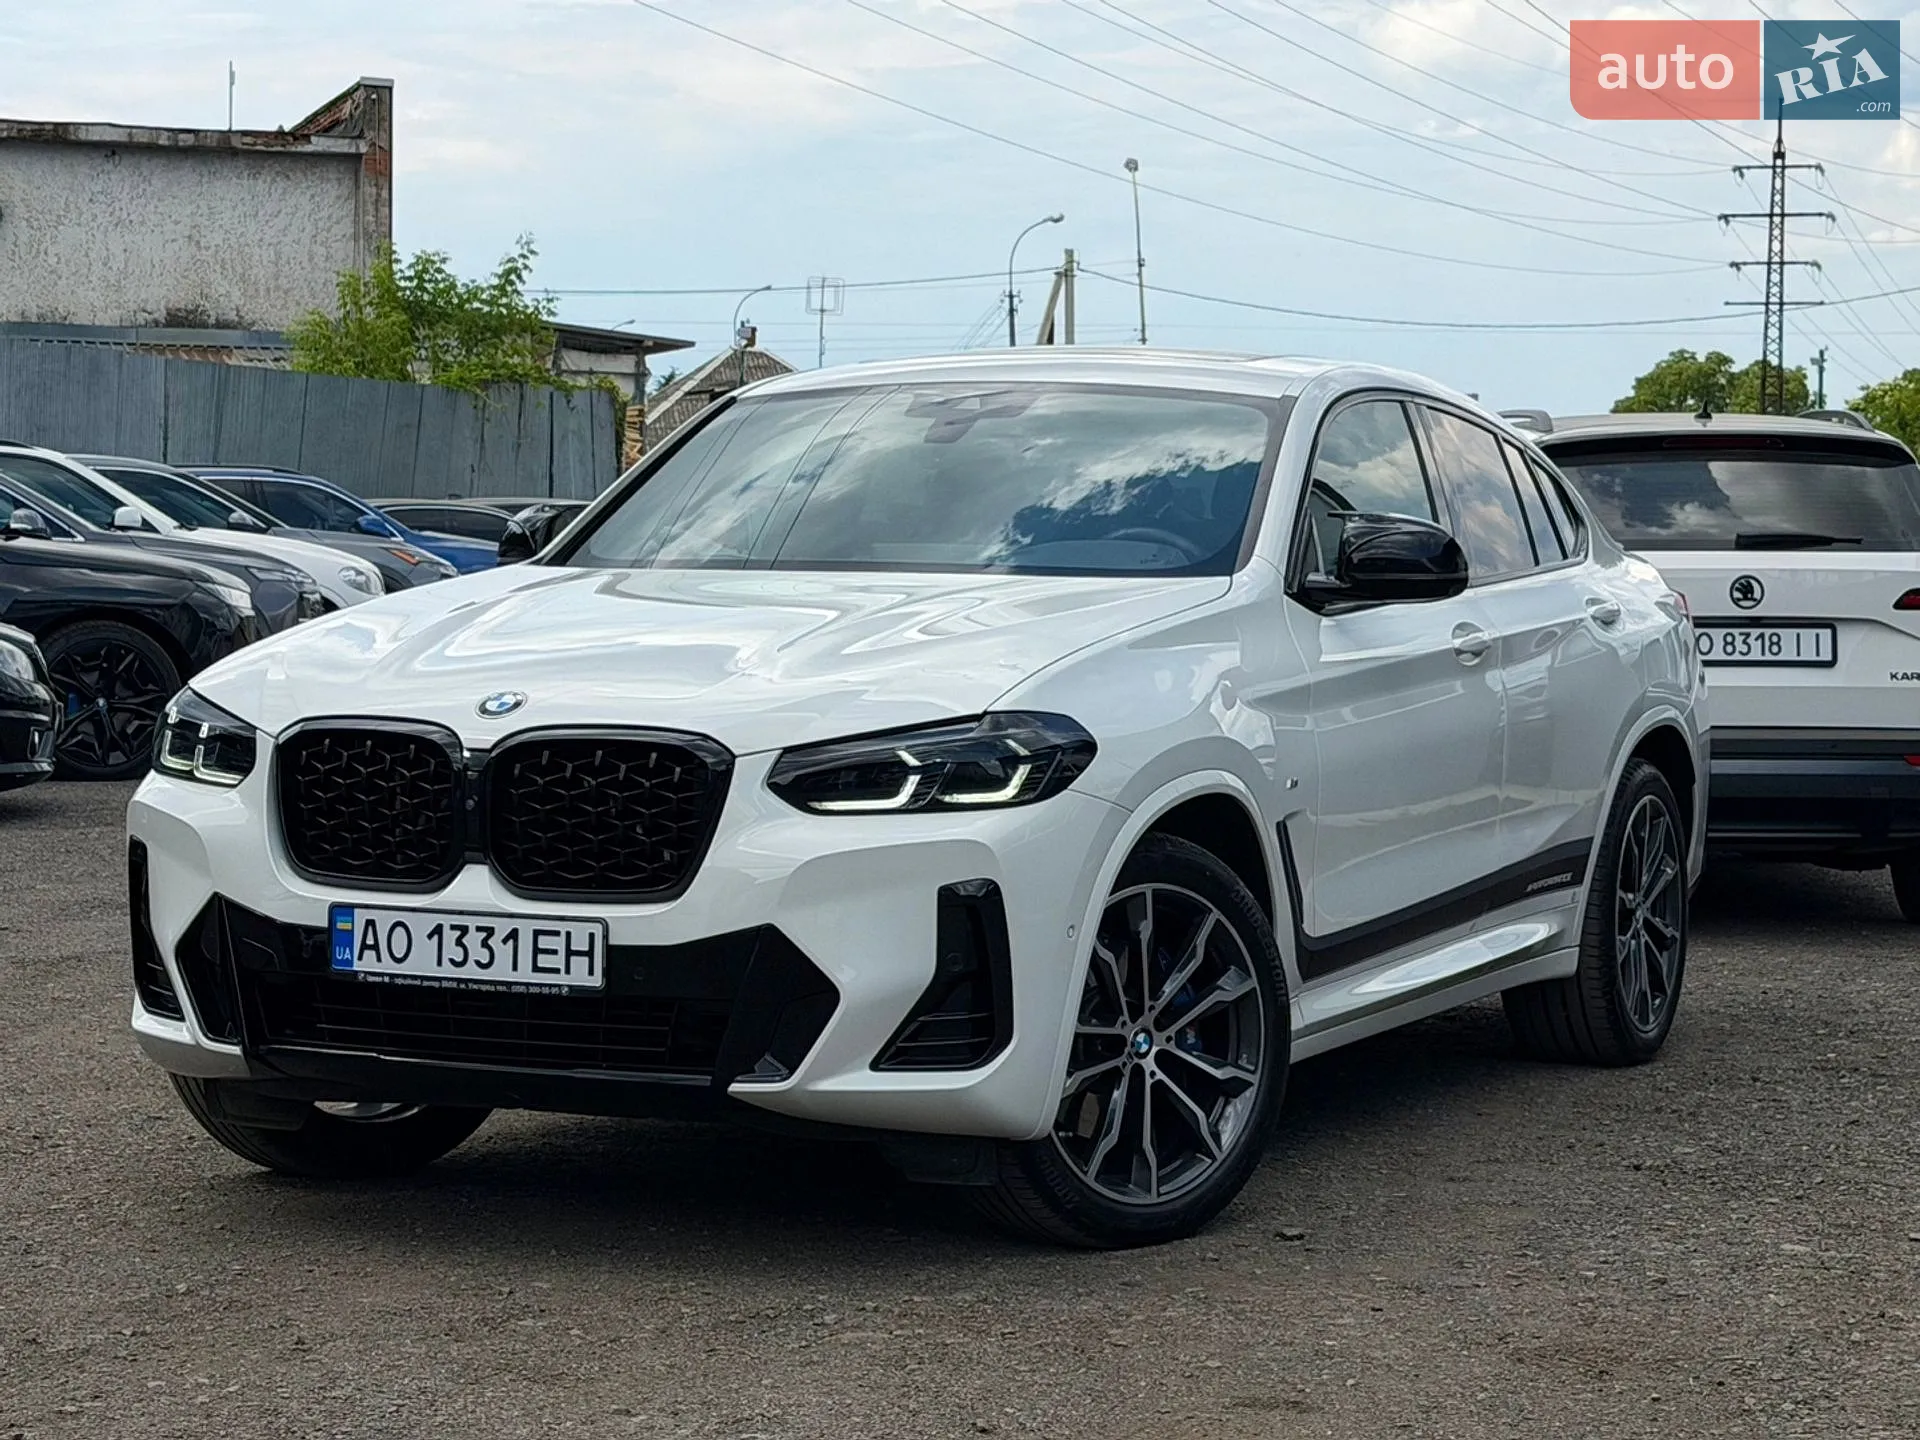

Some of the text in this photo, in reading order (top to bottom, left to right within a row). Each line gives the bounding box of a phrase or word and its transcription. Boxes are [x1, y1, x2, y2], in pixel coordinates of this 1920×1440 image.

[1722, 631, 1782, 657] 8318
[335, 945, 351, 960] UA
[357, 918, 596, 977] AO 1331 EH
